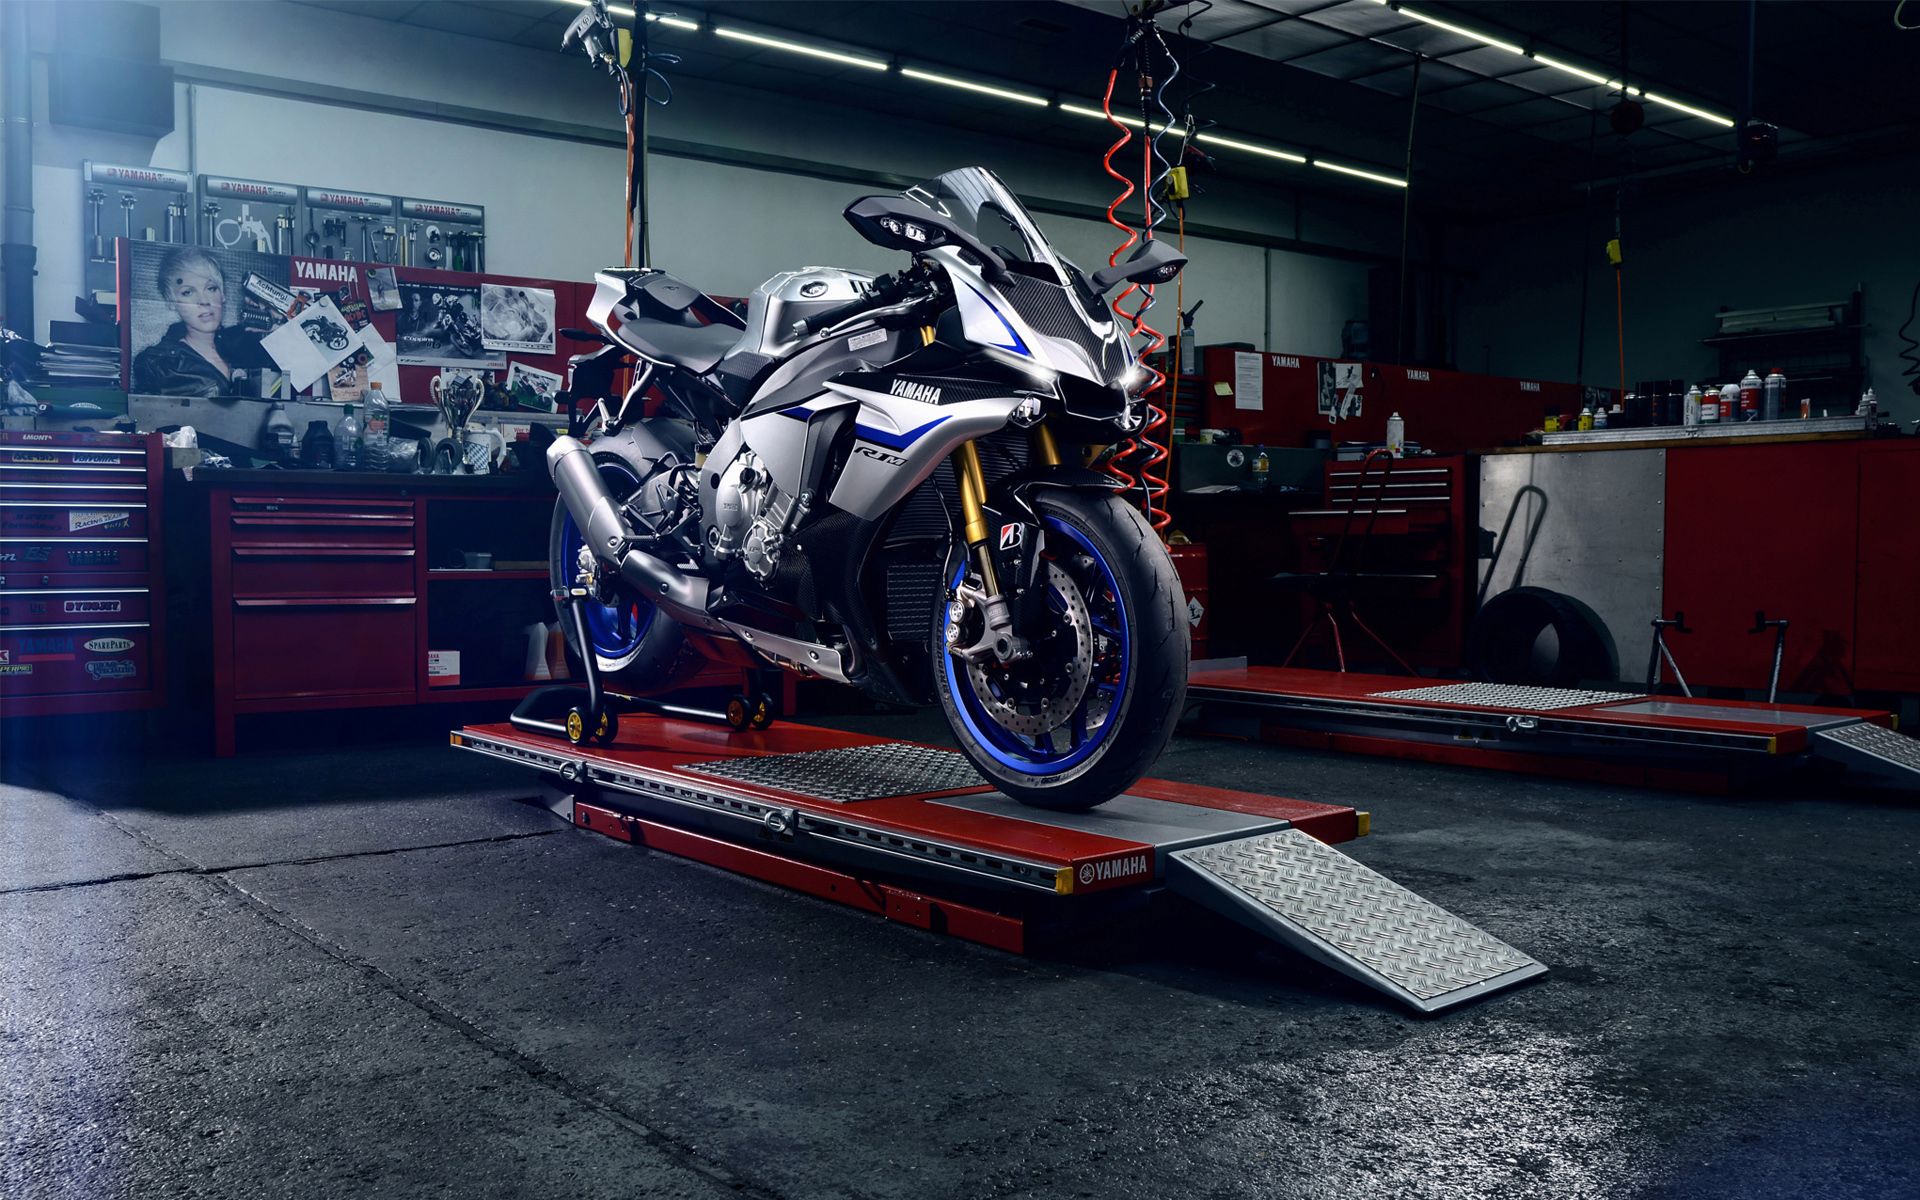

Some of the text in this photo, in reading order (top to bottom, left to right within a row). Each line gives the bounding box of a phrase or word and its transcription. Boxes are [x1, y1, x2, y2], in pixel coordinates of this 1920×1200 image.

[118, 168, 158, 183] YAMAHA
[231, 182, 269, 196] YAMAHA
[329, 193, 365, 207] YAMAHA
[423, 204, 457, 216] YAMAHA
[295, 260, 358, 283] YAMAHA
[256, 279, 289, 301] Achtung!
[1272, 355, 1300, 369] YAMAHA
[1406, 368, 1430, 382] YAMAHA
[889, 378, 942, 405] YAMAHA
[1519, 380, 1541, 392] YAMAHA
[854, 446, 908, 467] R1M
[1095, 855, 1147, 880] YAMAHA
